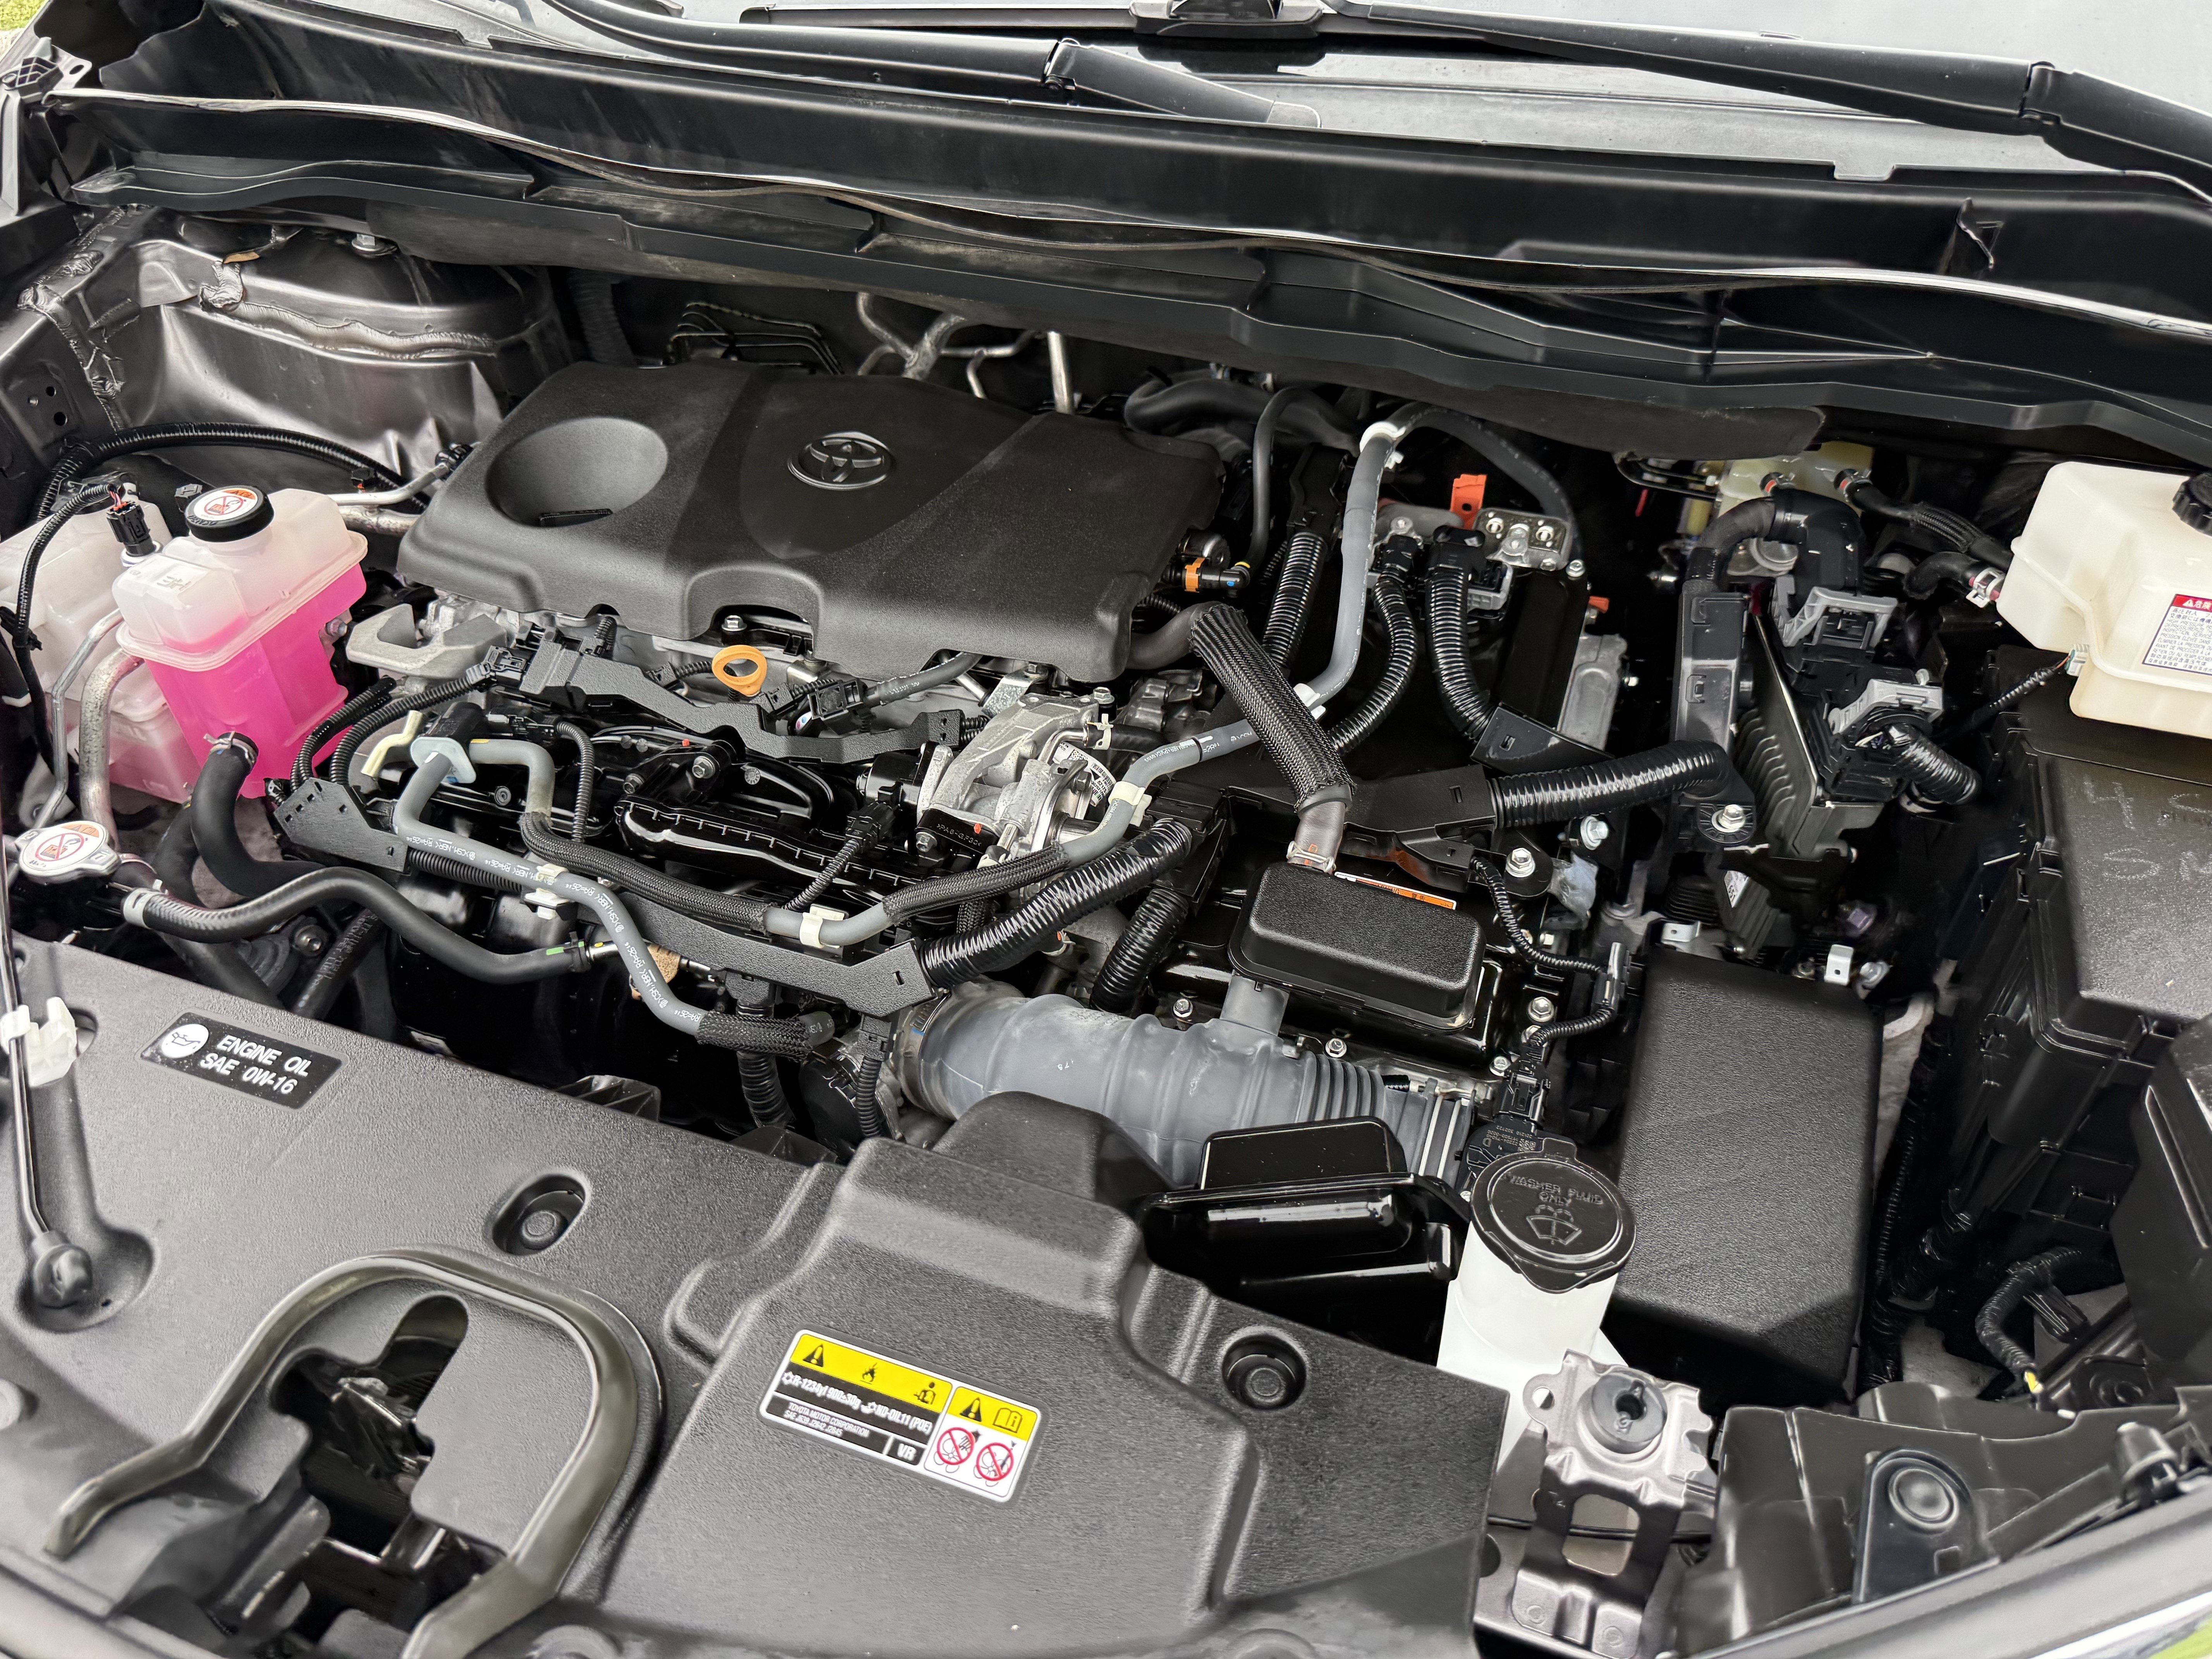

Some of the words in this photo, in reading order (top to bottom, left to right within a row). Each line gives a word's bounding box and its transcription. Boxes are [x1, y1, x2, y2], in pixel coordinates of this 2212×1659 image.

[216, 1034, 282, 1065] ENGINE
[283, 1056, 311, 1077] OIL
[200, 1053, 240, 1075] SAE
[242, 1066, 298, 1094] 0W-16
[1510, 1176, 1561, 1195] WASHER
[1568, 1188, 1604, 1205] FLUID
[1539, 1191, 1571, 1207] ONLY
[783, 1410, 797, 1420] SAE
[788, 1402, 810, 1415] TOYOTA
[809, 1410, 831, 1423] MOTOR
[831, 1417, 870, 1438] CORPORATION
[897, 1443, 917, 1461] VR
